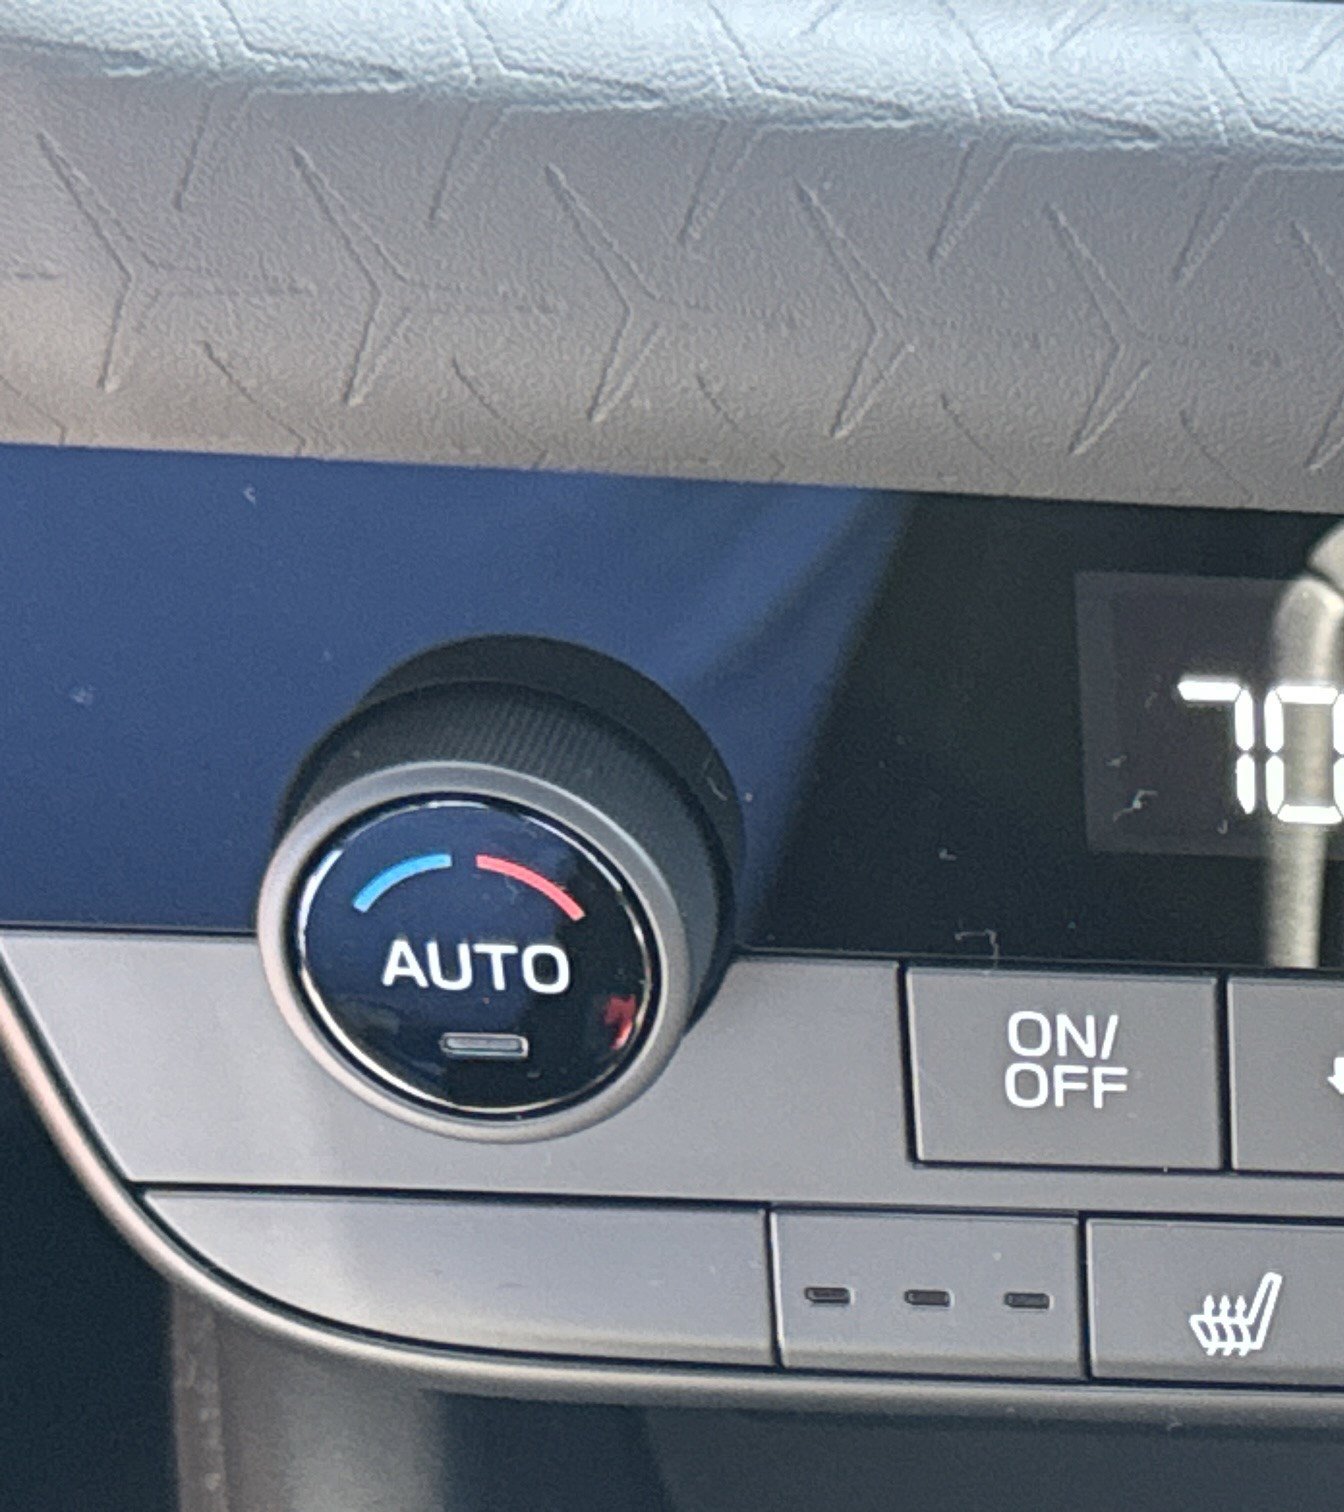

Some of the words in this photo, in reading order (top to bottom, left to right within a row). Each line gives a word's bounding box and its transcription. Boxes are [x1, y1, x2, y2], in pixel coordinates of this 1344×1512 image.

[381, 938, 571, 996] AUTO
[1006, 1009, 1120, 1060] ON/
[1003, 1061, 1129, 1110] OFF
